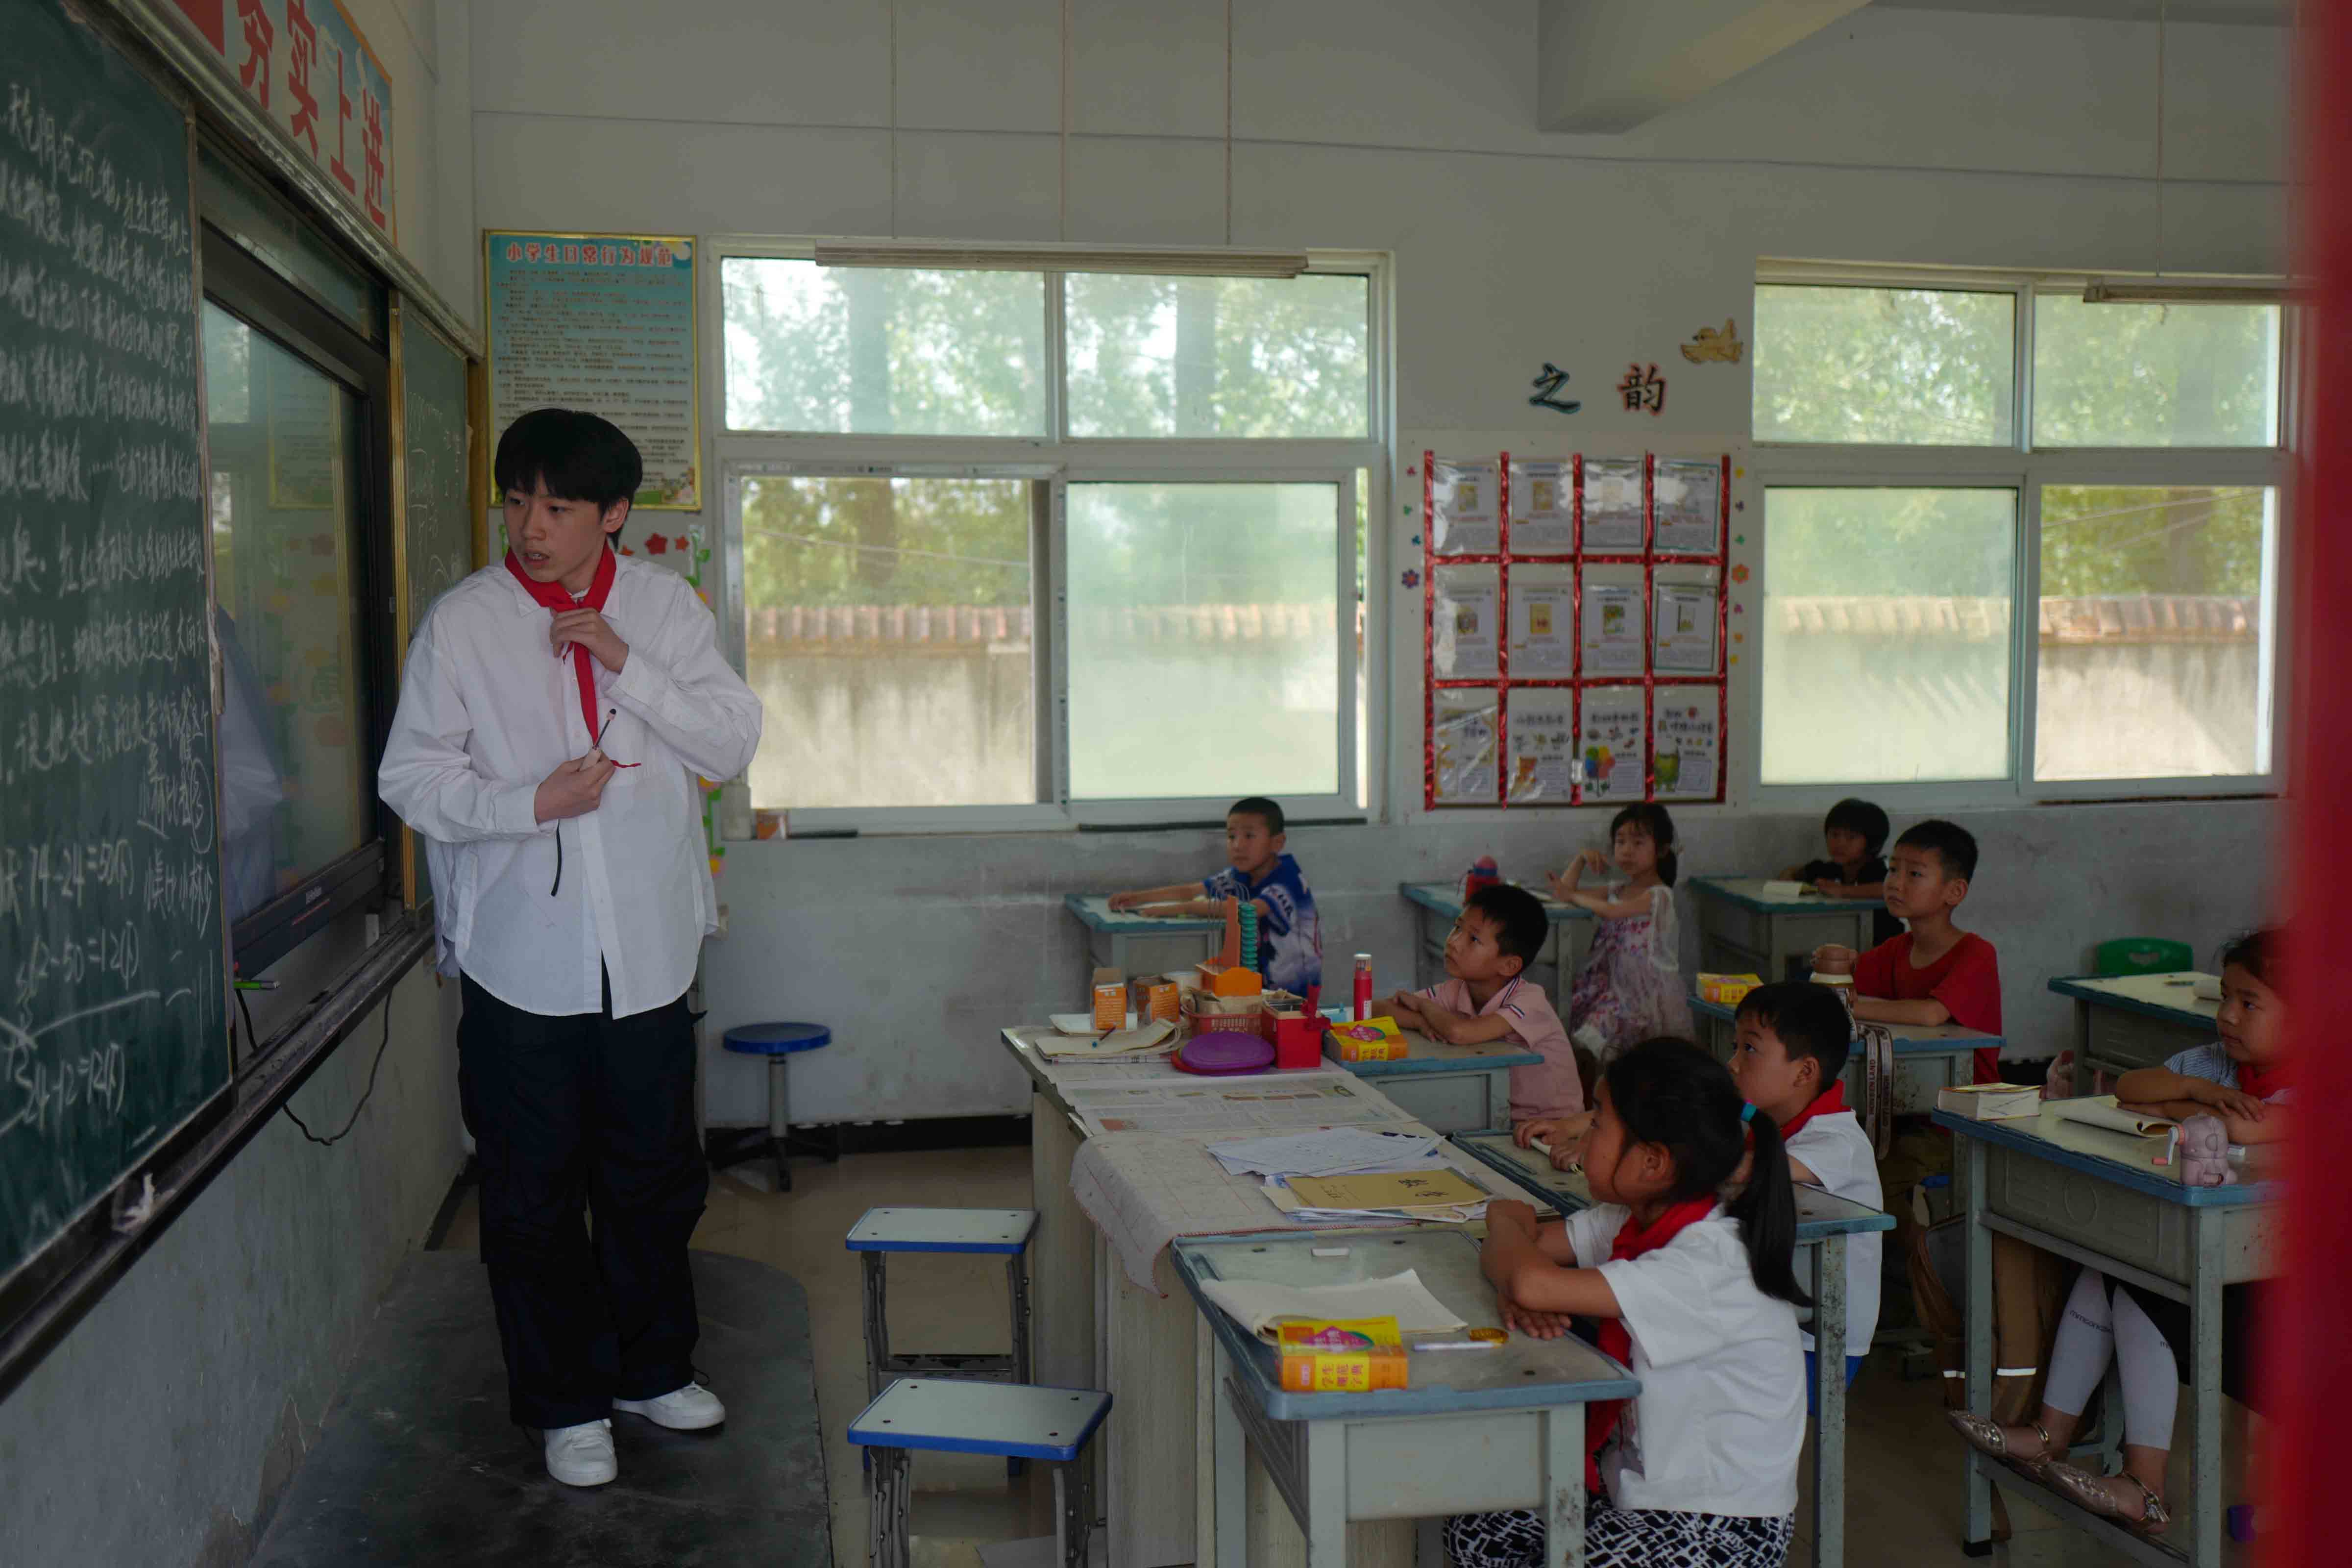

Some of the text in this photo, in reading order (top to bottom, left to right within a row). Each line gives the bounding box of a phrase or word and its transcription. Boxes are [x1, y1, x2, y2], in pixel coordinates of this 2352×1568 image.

[506, 243, 673, 267] 小学生日常行为规范
